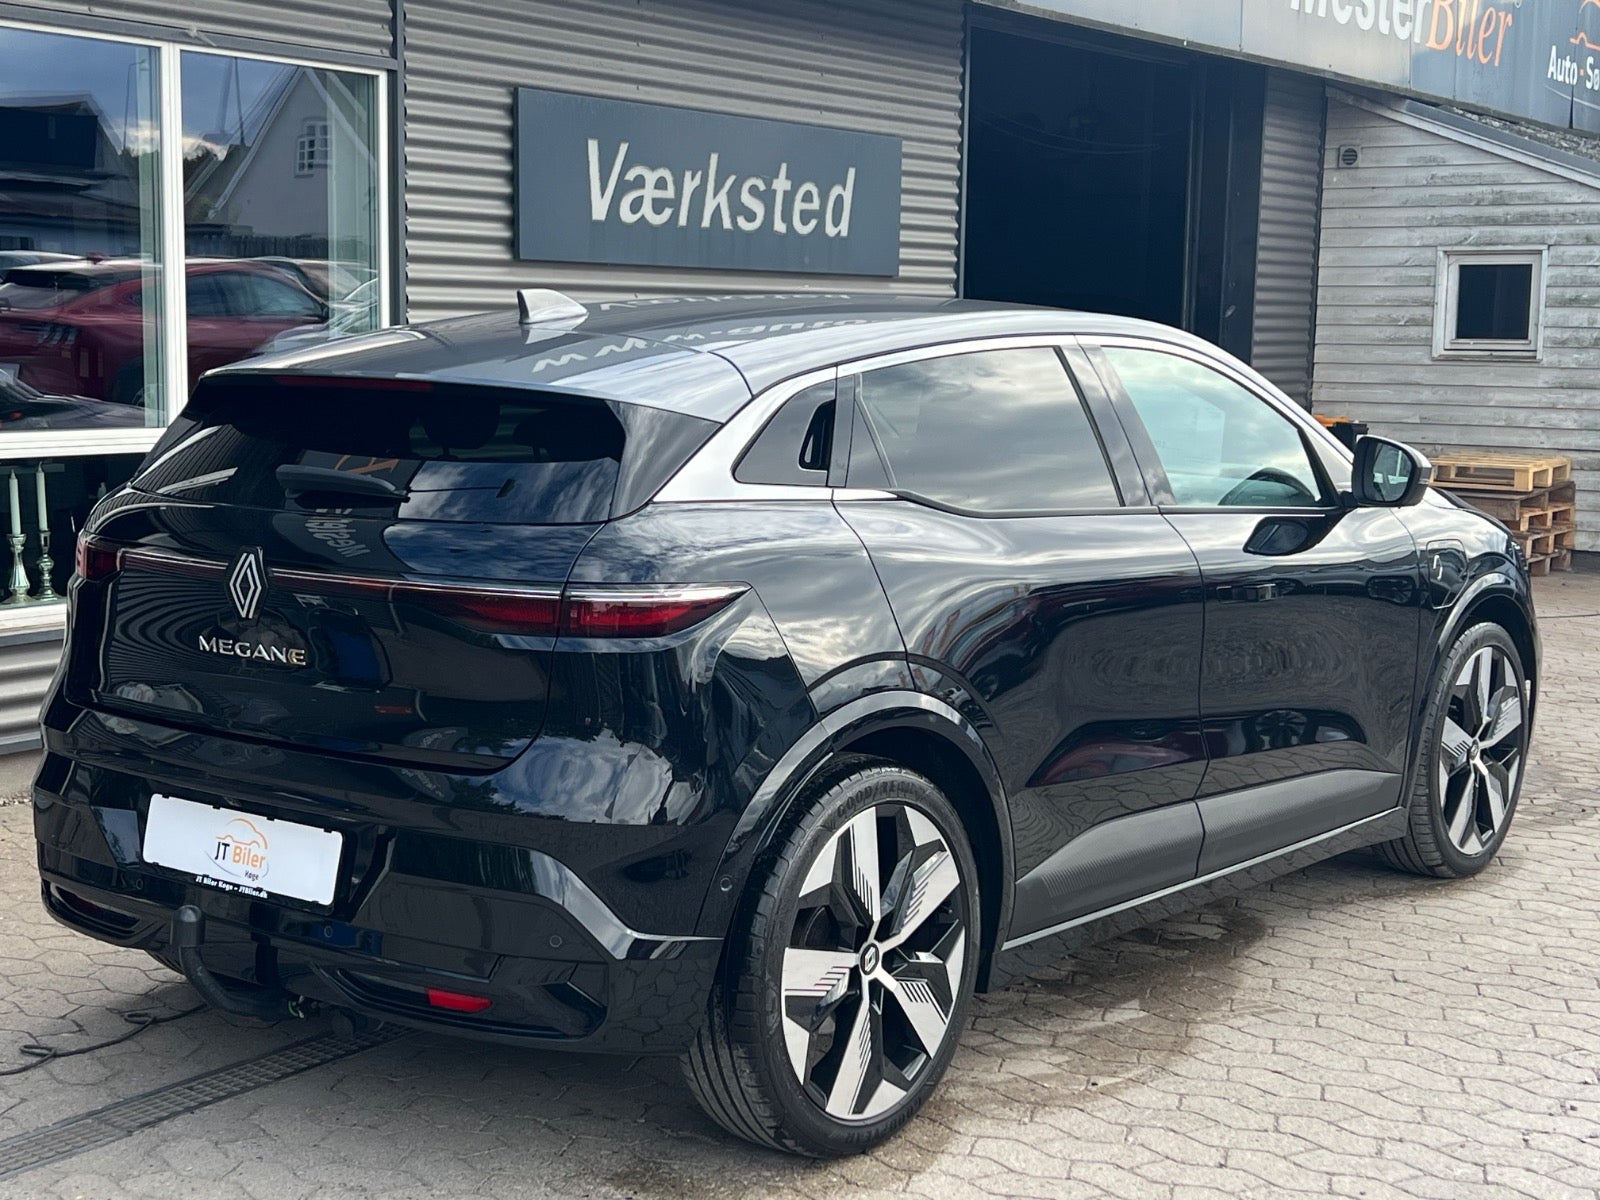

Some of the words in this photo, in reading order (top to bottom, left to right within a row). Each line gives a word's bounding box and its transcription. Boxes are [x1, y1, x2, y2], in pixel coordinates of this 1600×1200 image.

[587, 138, 856, 237] Værksted
[198, 634, 307, 666] MEGANE
[214, 841, 230, 861] JT
[233, 845, 266, 868] Biler
